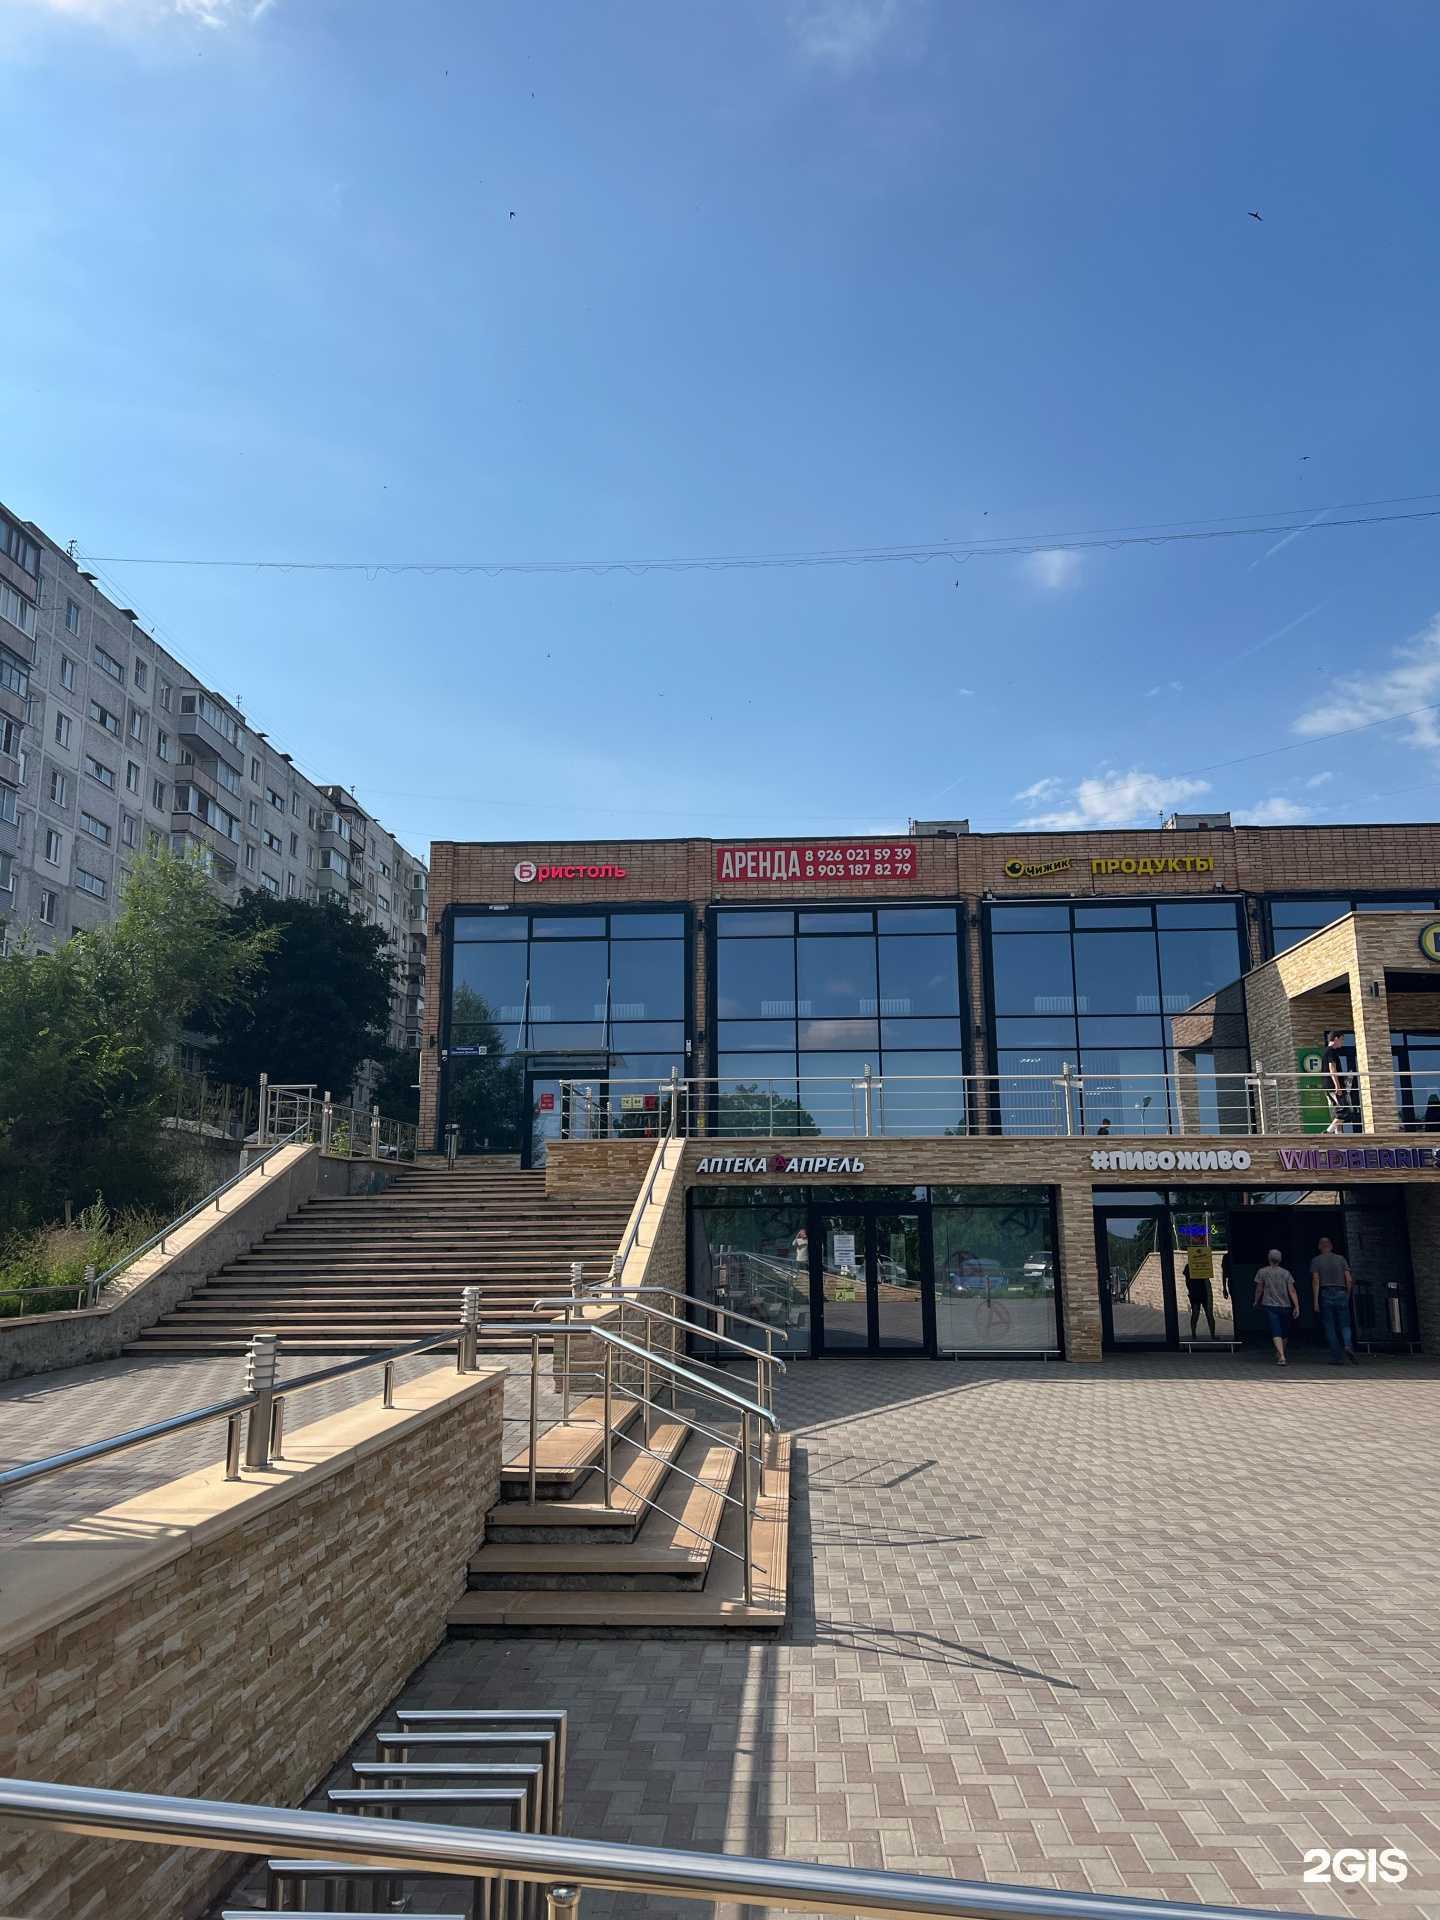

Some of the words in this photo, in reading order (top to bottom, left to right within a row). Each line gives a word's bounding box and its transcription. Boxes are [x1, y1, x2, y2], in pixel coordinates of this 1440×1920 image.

[805, 849, 813, 862] 8
[817, 848, 842, 861] 926
[846, 849, 870, 861] 021
[874, 848, 891, 860] 59
[895, 848, 911, 860] 39
[515, 861, 626, 882] Бристоль
[721, 850, 801, 881] АРЕНДА
[805, 864, 814, 877] 8
[818, 864, 845, 876] 903
[848, 864, 870, 876] 187
[874, 864, 891, 876] 82
[895, 863, 911, 875] 79
[1091, 856, 1215, 876] ПРОДУКТЫ
[696, 1157, 767, 1173] АПТЕКА
[785, 1157, 864, 1173] АПРЕЛЬ
